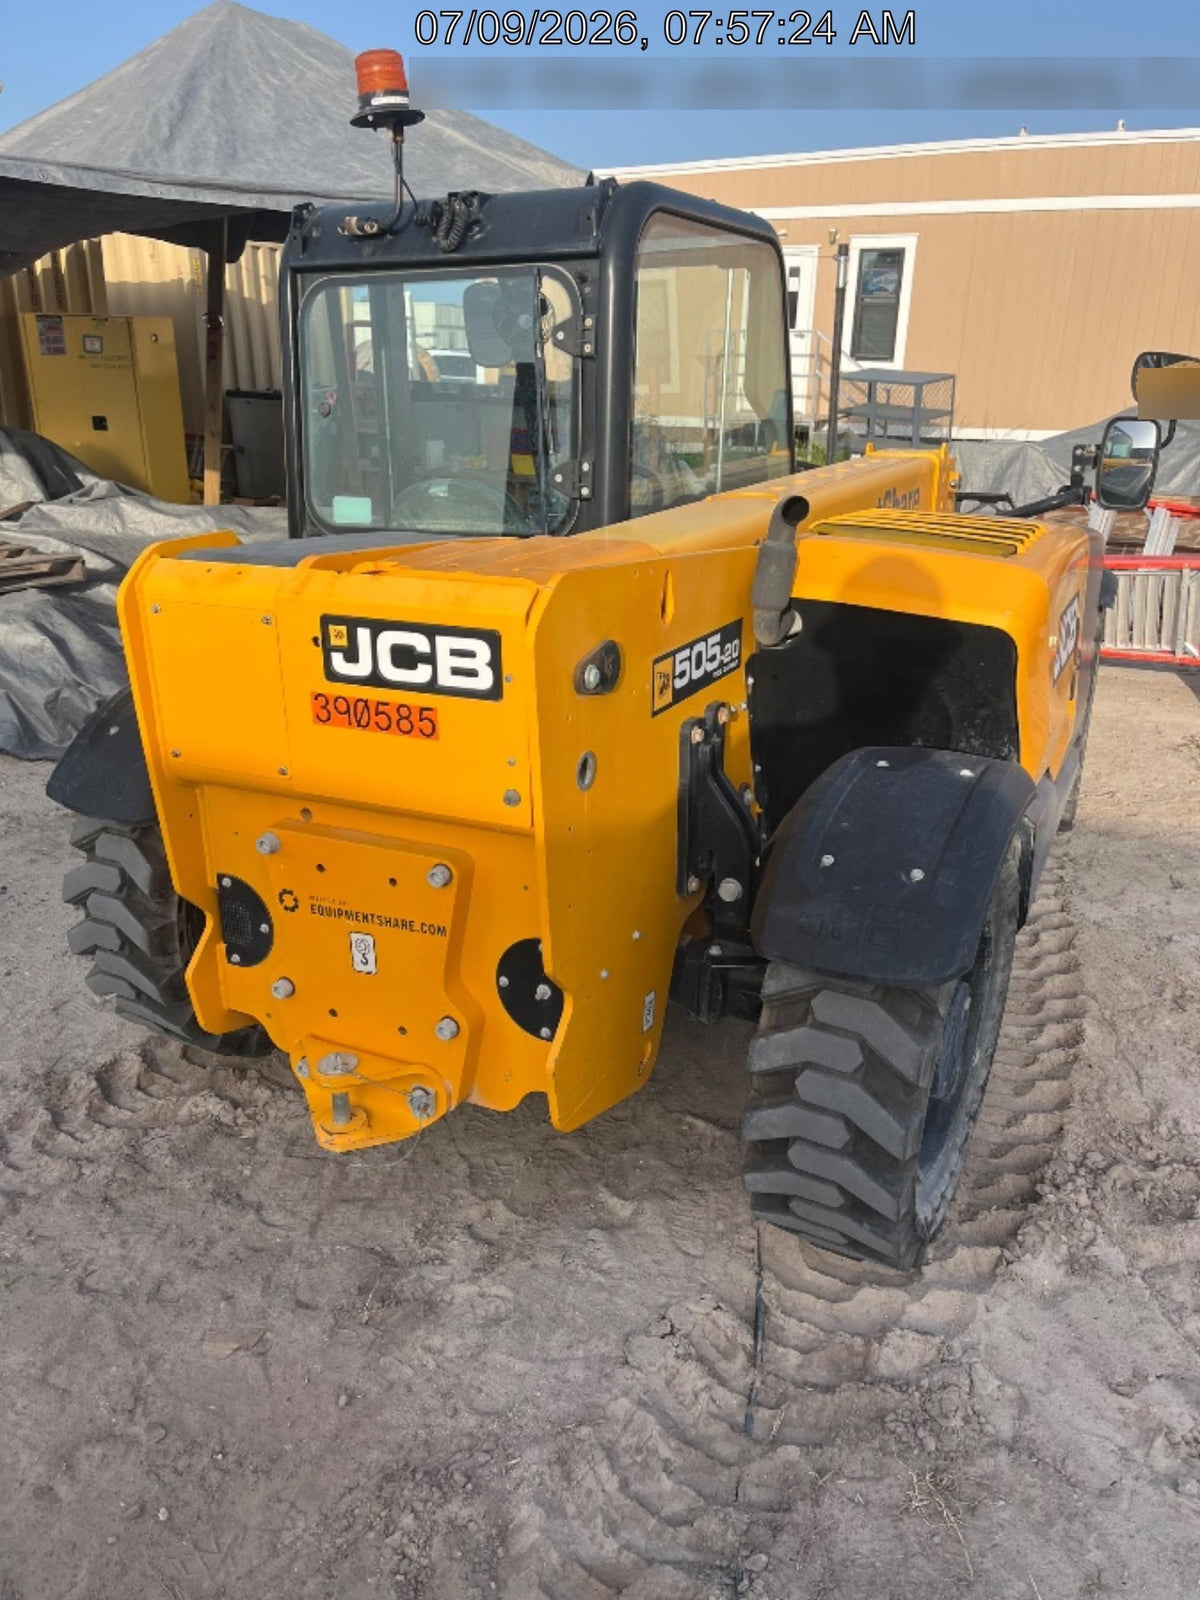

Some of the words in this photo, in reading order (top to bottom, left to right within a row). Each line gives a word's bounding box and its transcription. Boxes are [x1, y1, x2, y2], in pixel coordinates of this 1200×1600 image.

[331, 626, 494, 691] JCB
[673, 632, 740, 689] 505-20
[313, 693, 437, 738] 390585
[310, 903, 448, 938] EQUIPMENTSHARE.COM
